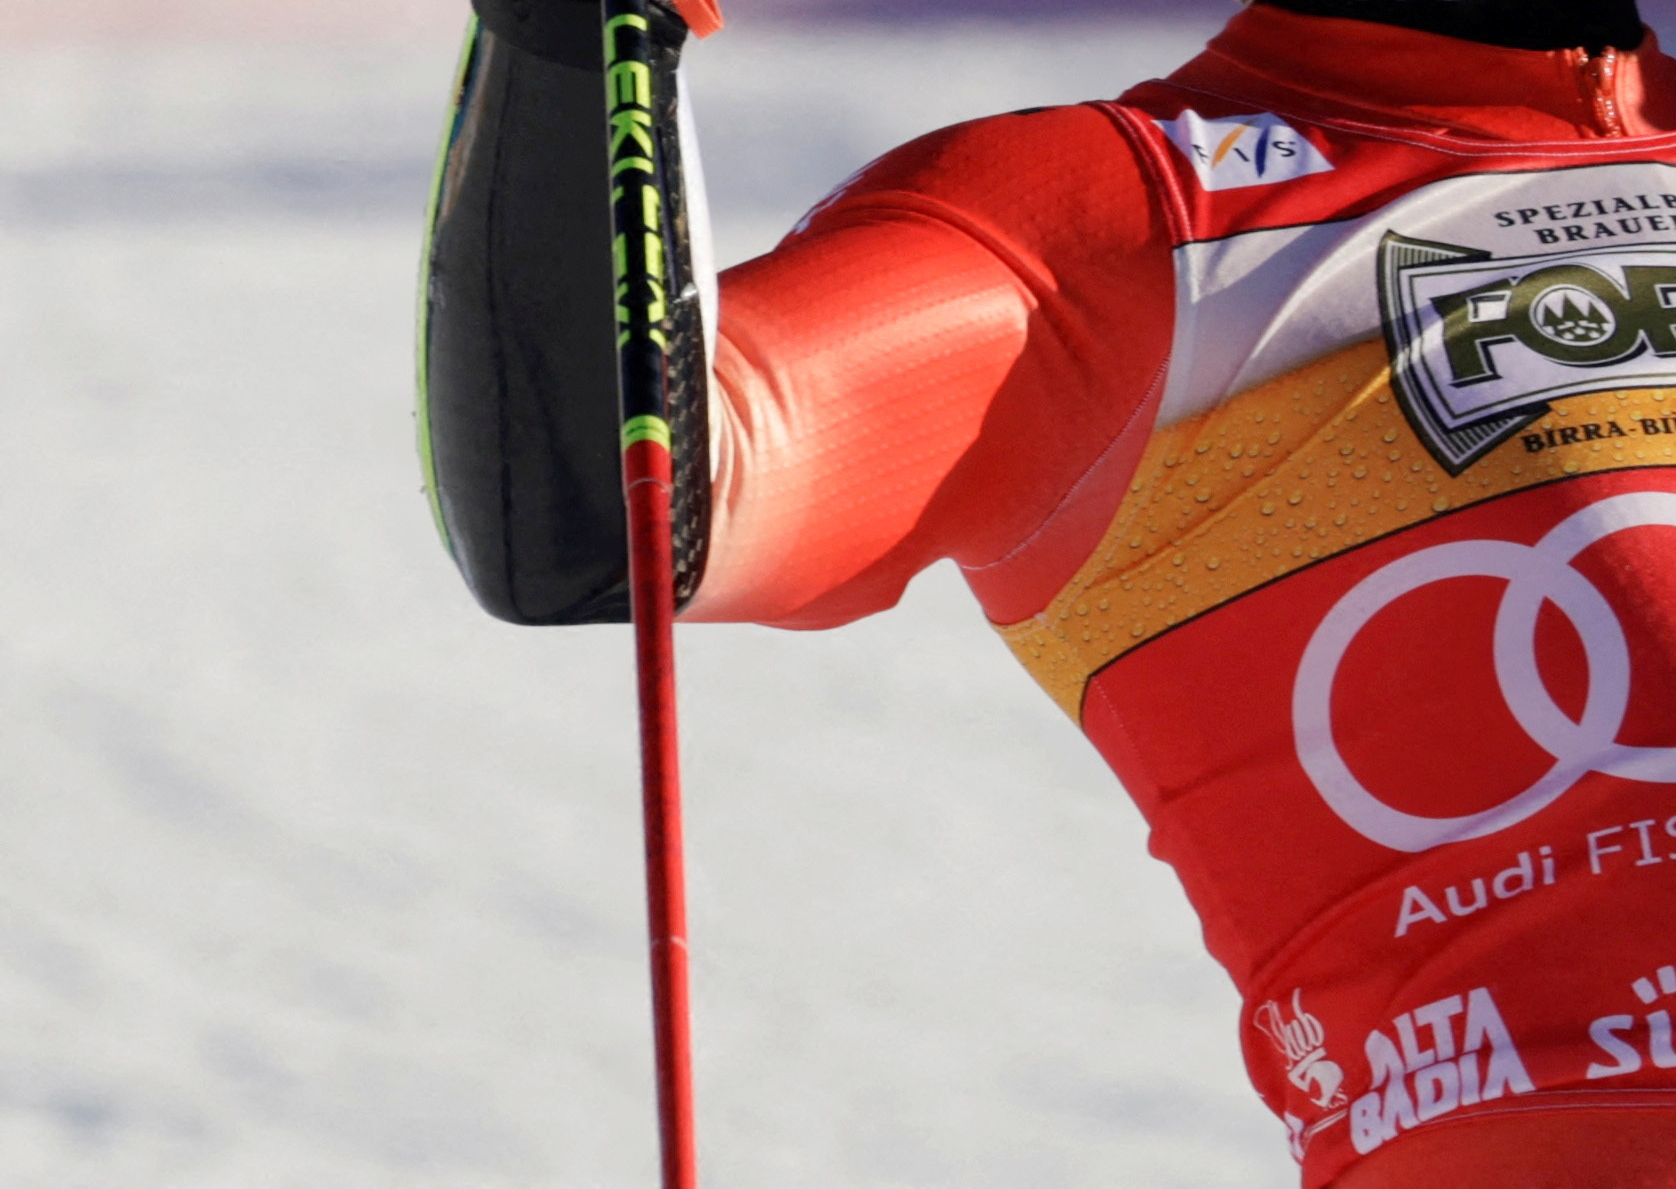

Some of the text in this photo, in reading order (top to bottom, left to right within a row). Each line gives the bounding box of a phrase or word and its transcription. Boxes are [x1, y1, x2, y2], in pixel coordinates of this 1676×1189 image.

[1395, 846, 1555, 938] Audi
[1364, 987, 1513, 1090] ALTA
[1350, 1051, 1536, 1155] BADIA
